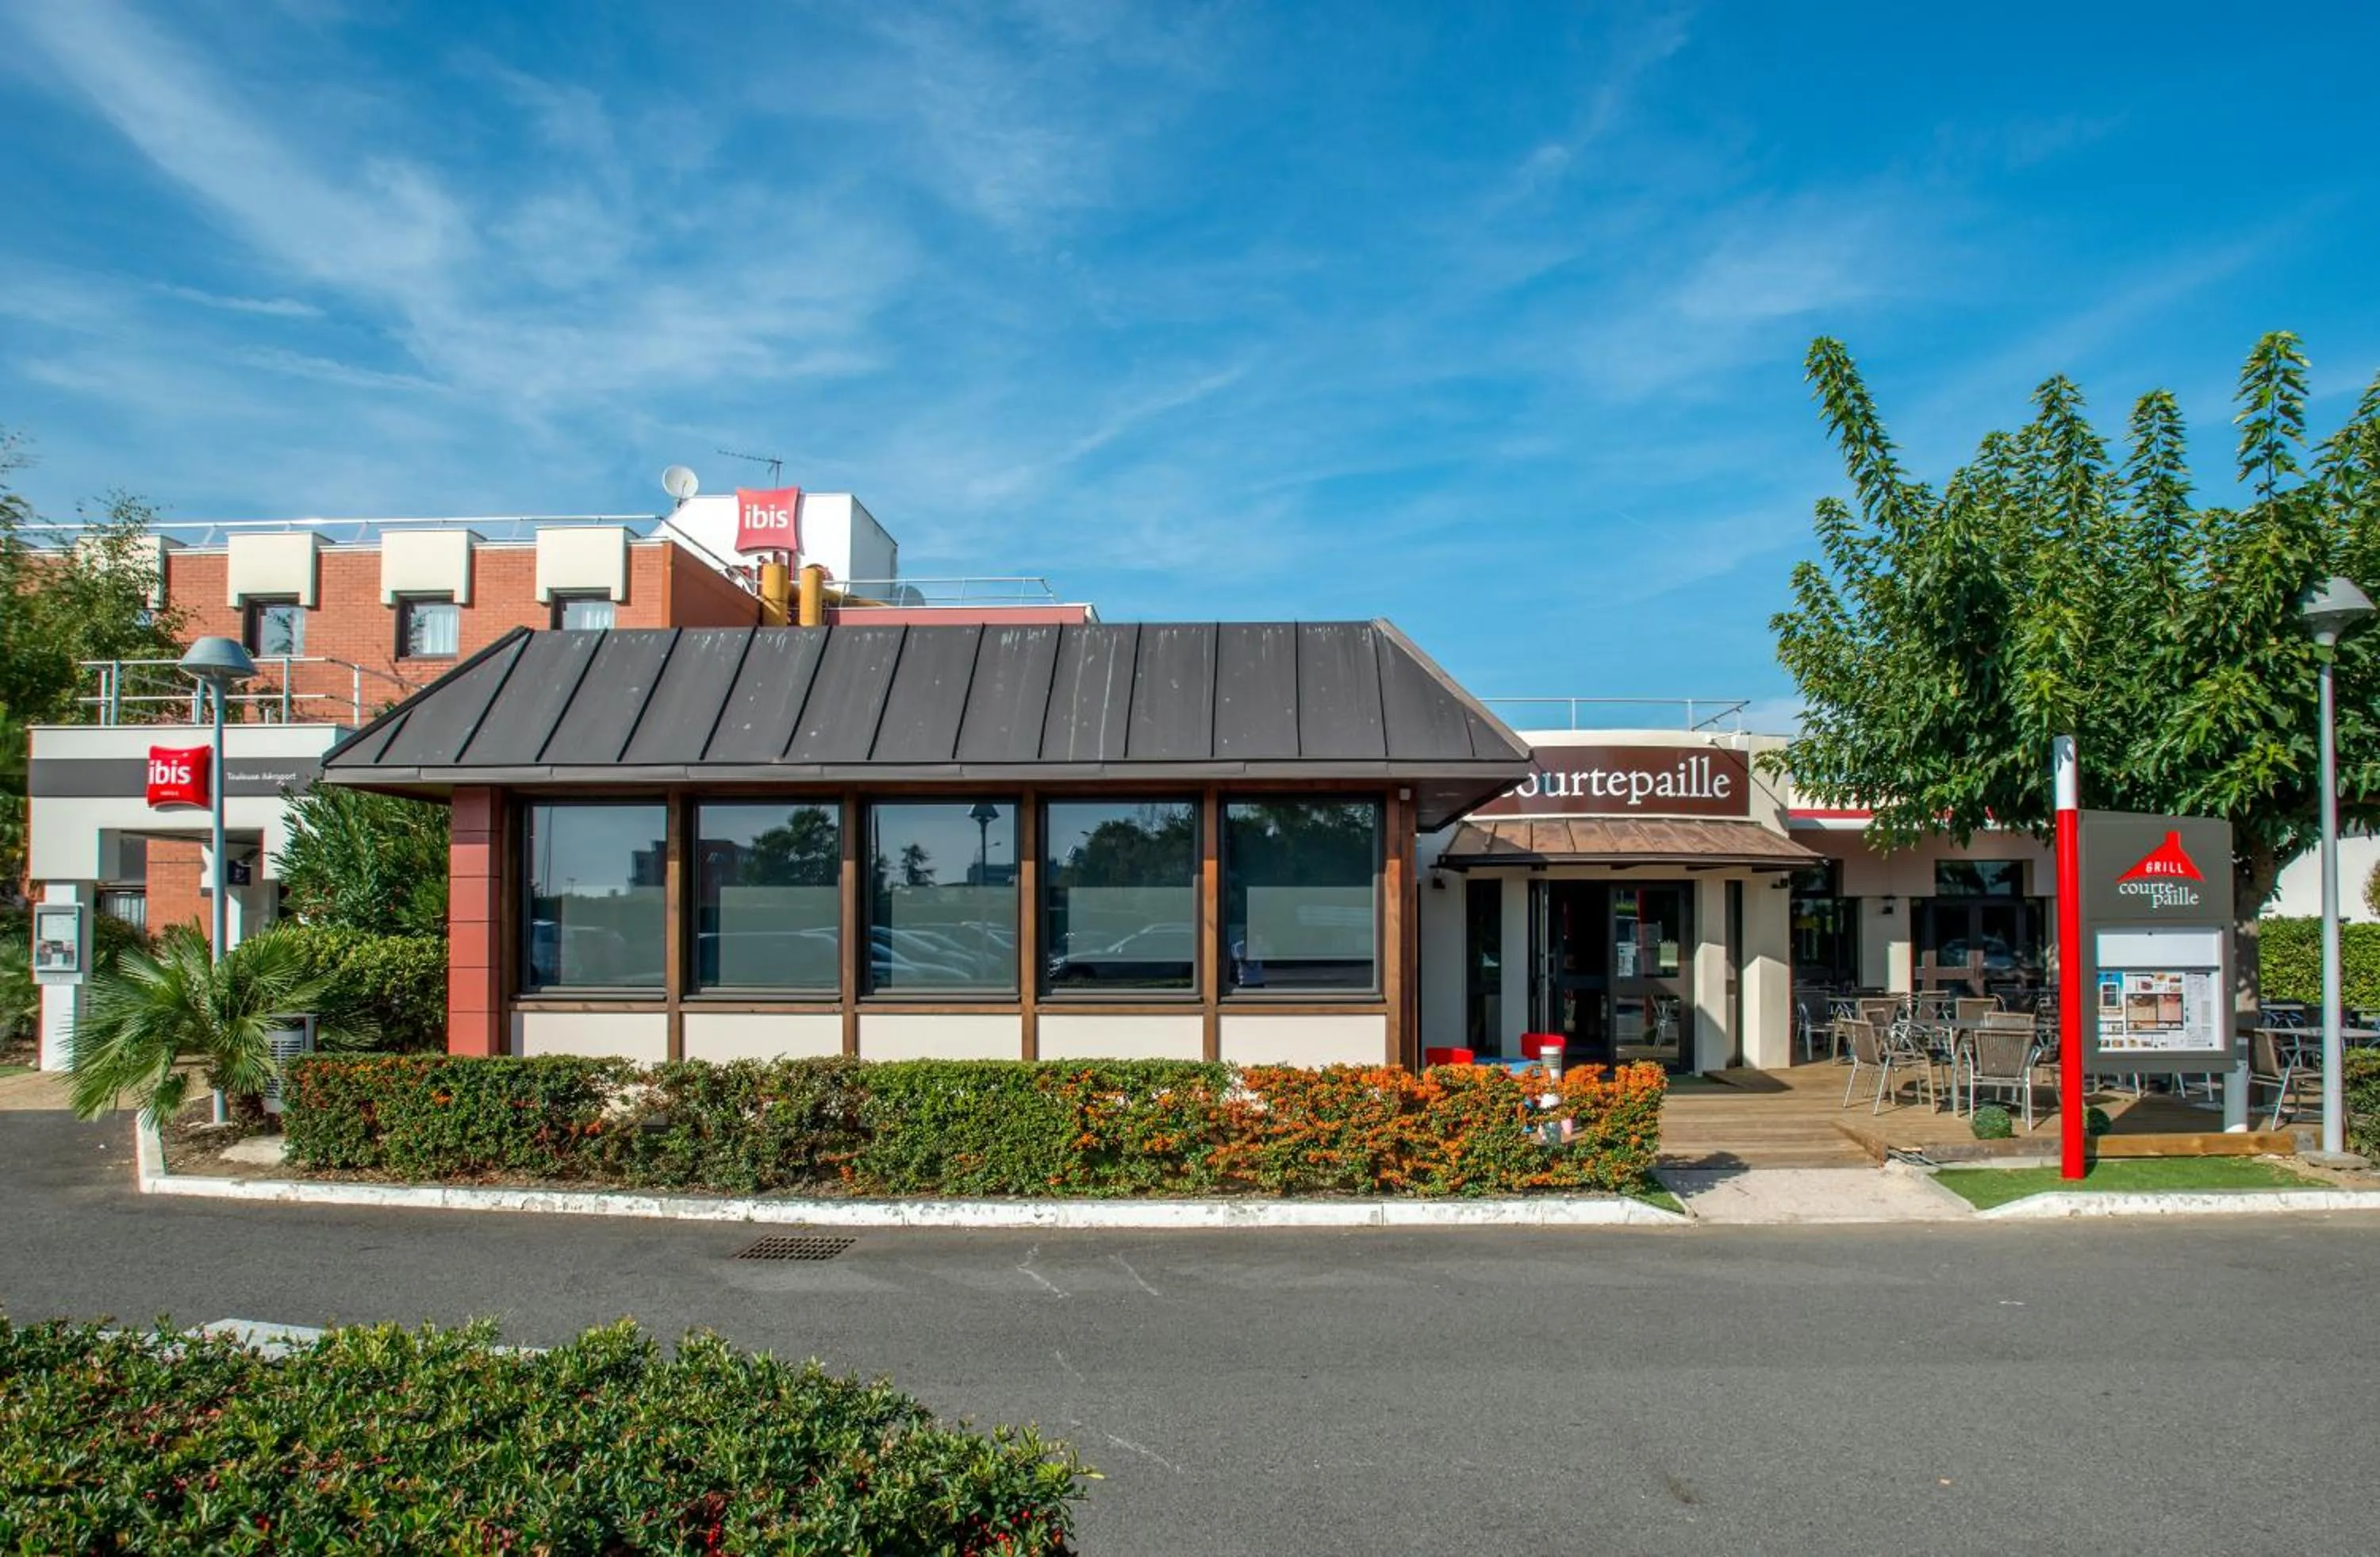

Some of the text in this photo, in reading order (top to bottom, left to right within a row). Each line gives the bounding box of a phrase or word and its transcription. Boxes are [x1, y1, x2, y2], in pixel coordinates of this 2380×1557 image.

[744, 505, 788, 529] ibis
[148, 760, 191, 784] ibis
[1500, 756, 1731, 805] ourtepaille
[2145, 861, 2183, 874] GRILL
[2119, 882, 2175, 894] courte
[2152, 887, 2199, 909] paille
